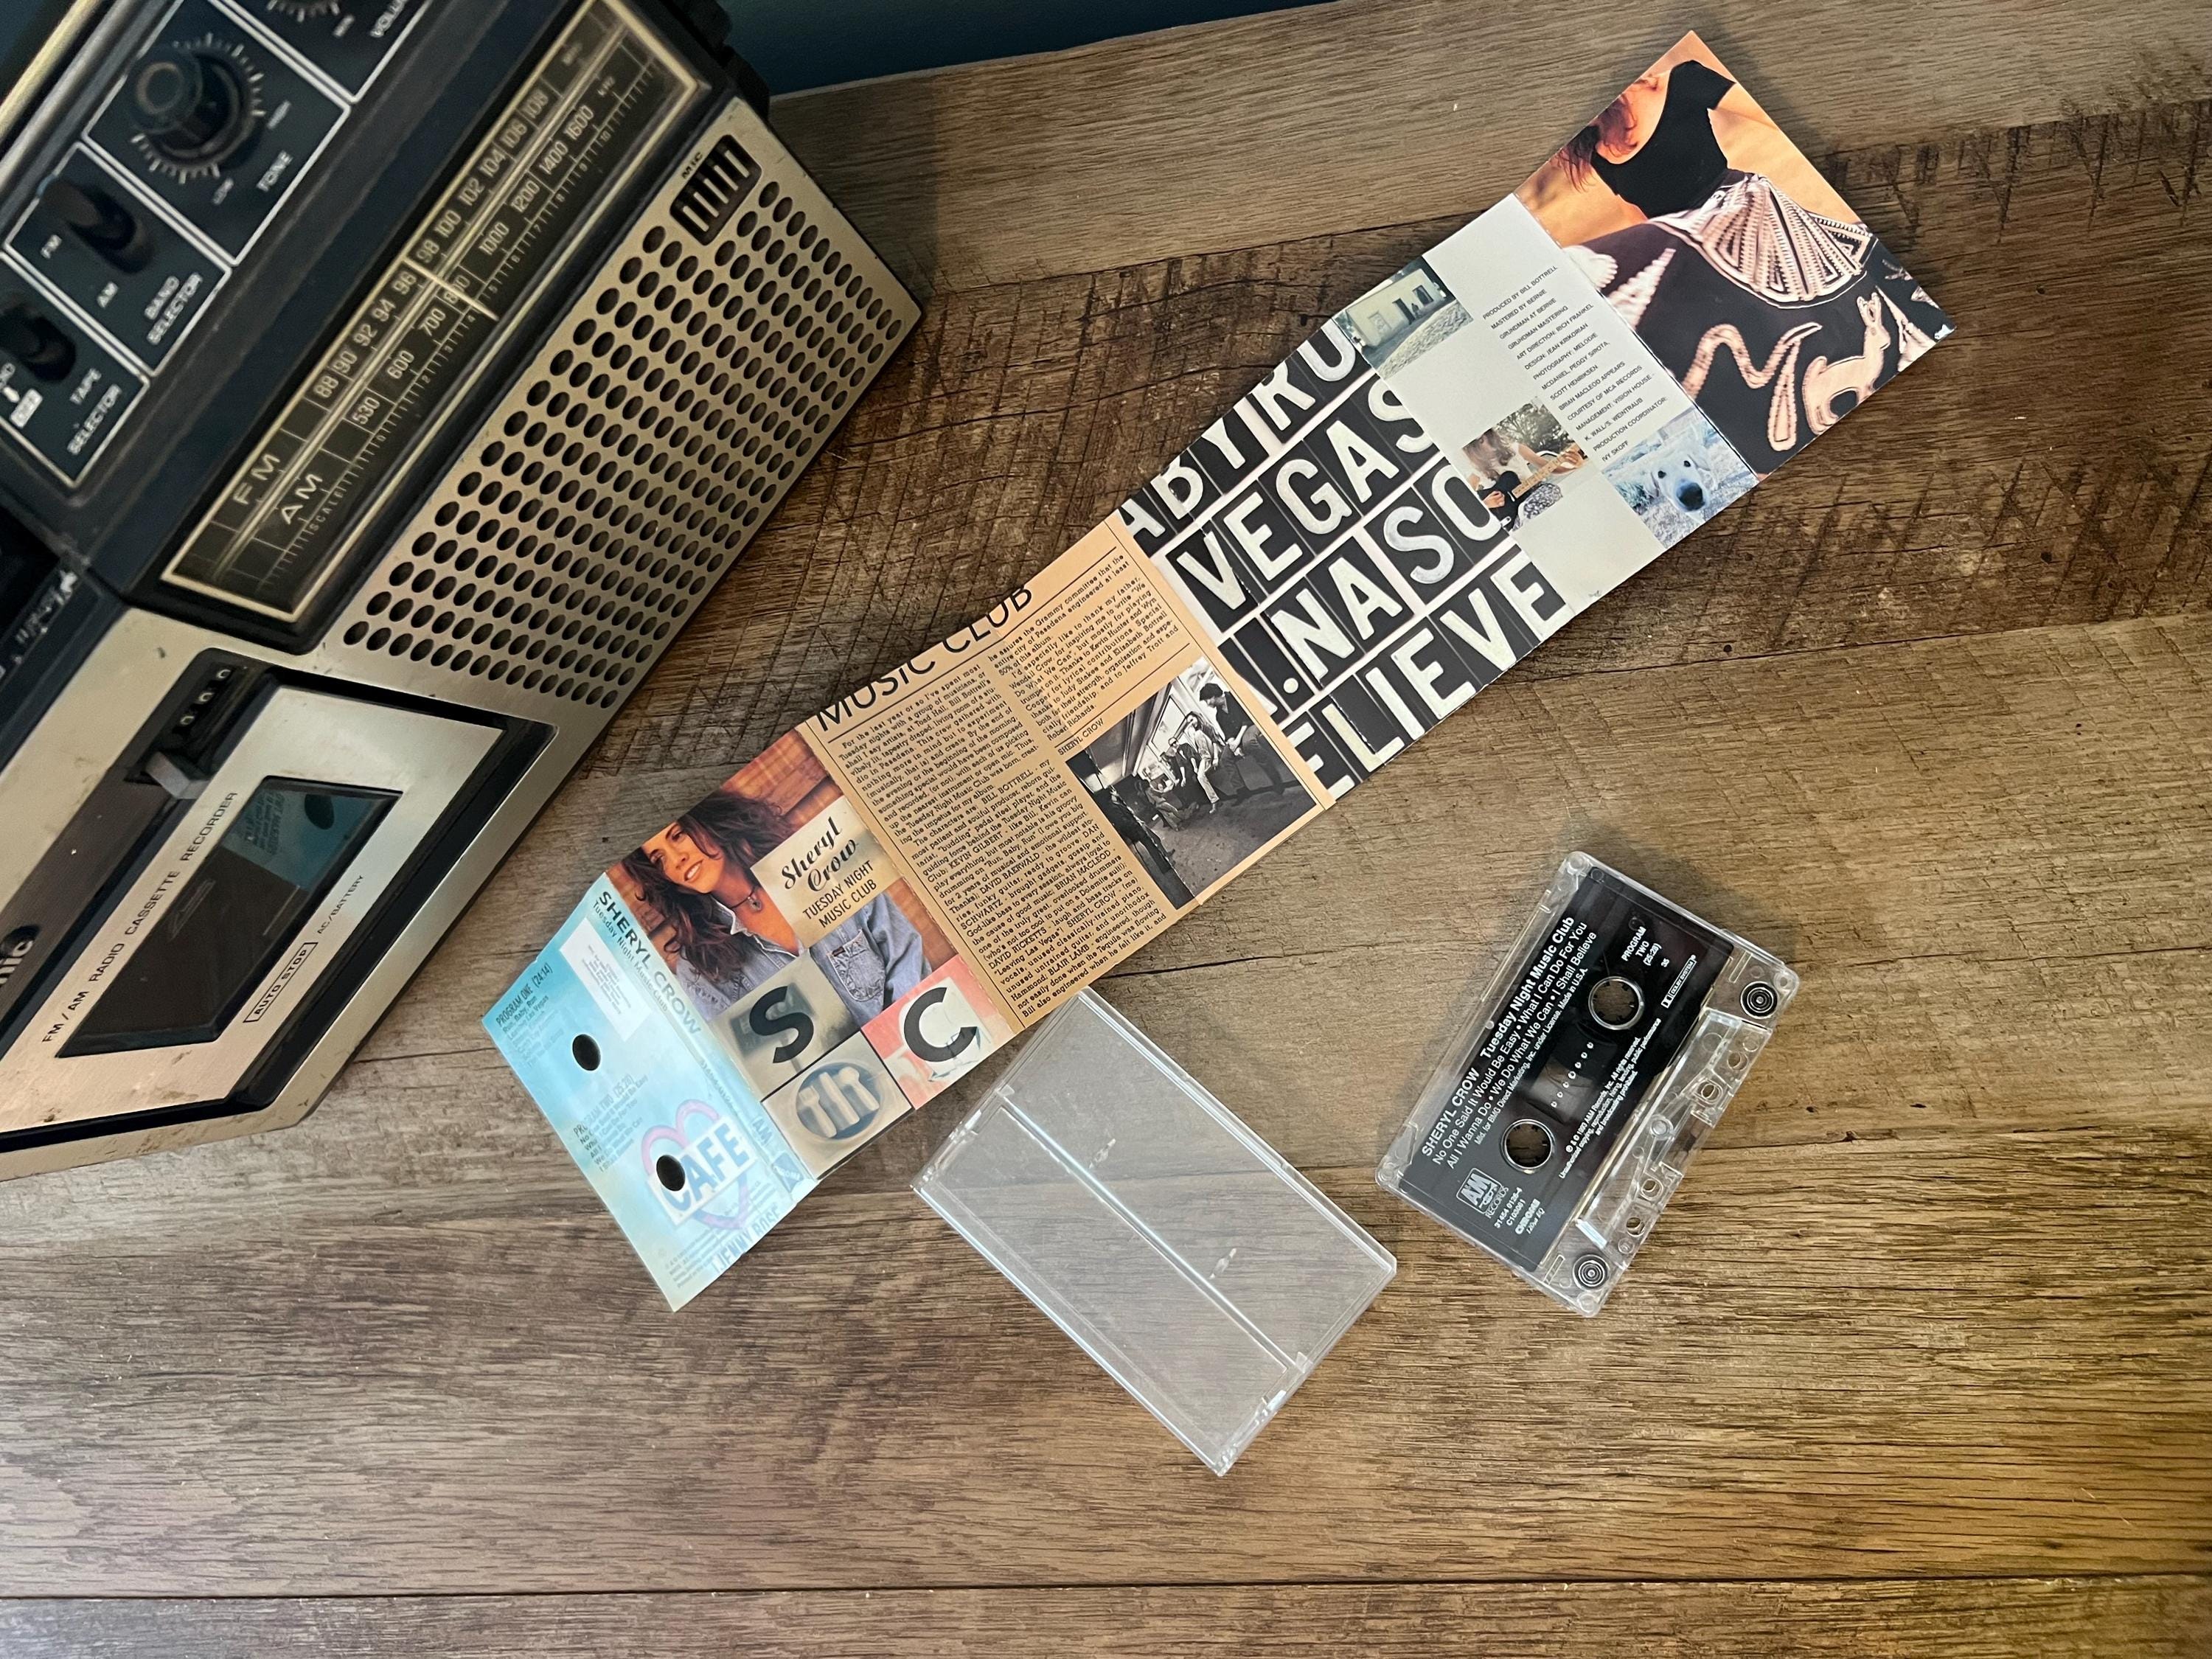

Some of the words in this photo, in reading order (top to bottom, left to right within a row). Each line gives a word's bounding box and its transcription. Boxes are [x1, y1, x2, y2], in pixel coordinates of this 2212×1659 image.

[257, 150, 293, 192] TONE
[681, 151, 703, 178] MIC
[97, 282, 117, 307] AM
[144, 275, 180, 320] BAND
[147, 273, 203, 345] SELECTOR
[232, 453, 281, 505] FM
[313, 374, 339, 398] 88
[331, 349, 358, 373] 90
[352, 322, 378, 347] 92
[371, 298, 397, 321] 94
[392, 271, 417, 294] 96
[416, 238, 440, 263] 98
[434, 209, 462, 237] 100
[457, 177, 484, 206] 102
[479, 147, 507, 177] 104
[500, 119, 528, 148] 106
[521, 88, 549, 119] 108
[279, 473, 323, 524] AM
[351, 396, 380, 425] 530
[386, 349, 415, 379] 600
[418, 307, 447, 336] 700
[478, 221, 510, 255] 1000
[509, 179, 540, 212] 1200
[538, 139, 569, 175] 1400
[563, 104, 594, 140] 1600
[1482, 297, 1512, 320] PRODUCED
[1510, 291, 1520, 299] BY
[1519, 284, 1531, 294] BILL
[1530, 265, 1558, 286] BOTTRELL
[1516, 349, 1527, 360] ART
[1555, 320, 1570, 332] RICH
[1568, 303, 1594, 322] FRANKEL
[69, 367, 102, 405] TAPE
[1549, 385, 1568, 400] SCOTT
[1567, 364, 1599, 388] HENRIKSEN
[1566, 397, 1596, 421] COURTESY
[1595, 392, 1604, 400] OF
[1602, 383, 1617, 395] MCA
[1615, 364, 1643, 386] RECORDS
[66, 383, 122, 455] SELECTOR
[1592, 424, 1628, 451] PRODUCTION
[1601, 452, 1611, 462] IVY
[1610, 439, 1628, 455] SKOFF
[1178, 378, 1439, 611] VEGAS
[814, 656, 936, 733] MUSIC
[940, 585, 1034, 655] CLUB
[841, 738, 855, 749] For
[855, 731, 869, 740] the
[869, 720, 886, 733] last
[886, 710, 903, 724] year
[905, 704, 914, 712] or
[924, 689, 939, 700] I've
[940, 675, 961, 691] spent
[962, 664, 981, 678] most
[1057, 735, 1083, 756] SHERYL
[1081, 717, 1104, 737] CROW
[912, 835, 928, 846] The
[928, 813, 964, 837] characters
[981, 791, 998, 804] BILL
[997, 768, 1034, 794] BOTTRELL
[781, 817, 844, 890] Sheryl
[810, 838, 859, 892] Crow
[87, 942, 125, 982] RADIO
[123, 870, 181, 936] CASSETTE
[178, 791, 239, 862] RECORDER
[316, 874, 364, 934] AC/BATTERY
[801, 882, 845, 919] TUESDAY
[843, 859, 874, 888] NIGHT
[817, 897, 852, 928] MUSIC
[849, 878, 877, 903] CLUB
[591, 900, 618, 938] Tuesday
[615, 936, 634, 961] Night
[633, 961, 653, 990] Music
[652, 989, 668, 1012] Club
[1558, 940, 1575, 959] For
[1568, 921, 1587, 941] You
[1621, 925, 1646, 961] PROGRAM
[1635, 940, 1649, 957] TWO
[253, 983, 282, 1015] AUTO
[280, 948, 307, 980] STOP
[597, 891, 652, 965] SHERYL
[653, 970, 702, 1034] CROW
[1021, 1004, 1036, 1018] Bill
[1036, 995, 1051, 1008] also
[1051, 967, 1089, 998] engineered
[1088, 955, 1109, 970] when
[1107, 948, 1119, 957] he
[1118, 939, 1131, 950] felt
[1129, 929, 1144, 941] like
[1152, 912, 1166, 925] and
[1537, 973, 1555, 994] Can
[1549, 959, 1564, 974] Do
[495, 993, 524, 1027] PROGRAM
[520, 982, 533, 1000] ONE
[530, 961, 553, 988] (24:14)
[526, 995, 537, 1008] Run
[1517, 998, 1540, 1024] What
[749, 986, 814, 1064] S
[904, 987, 978, 1062] C
[1421, 1108, 1457, 1156] SHERYL
[1451, 1067, 1480, 1107] CROW
[1479, 1010, 1517, 1059] Tuesday
[1509, 978, 1537, 1012] Night
[1528, 944, 1557, 979] Music
[1551, 916, 1574, 944] Club
[1446, 1153, 1459, 1169] All
[1456, 1116, 1483, 1149] Wanna
[1477, 1101, 1492, 1116] Do
[1489, 1078, 1506, 1095] We
[1500, 1063, 1515, 1079] Do
[1509, 1037, 1531, 1063] What
[1524, 1021, 1541, 1038] We
[1536, 1001, 1554, 1021] Can
[1555, 964, 1576, 990] Shall
[1569, 931, 1597, 966] Believe
[1499, 1029, 1521, 1055] Easy
[1472, 1067, 1497, 1098] Would
[1490, 1054, 1505, 1069] Be
[1454, 1105, 1473, 1128] Said
[1467, 1097, 1478, 1107] It
[1431, 1149, 1447, 1165] No
[1441, 1127, 1460, 1149] One
[662, 1127, 752, 1215] CAFE
[1484, 1185, 1509, 1219] RECORDS
